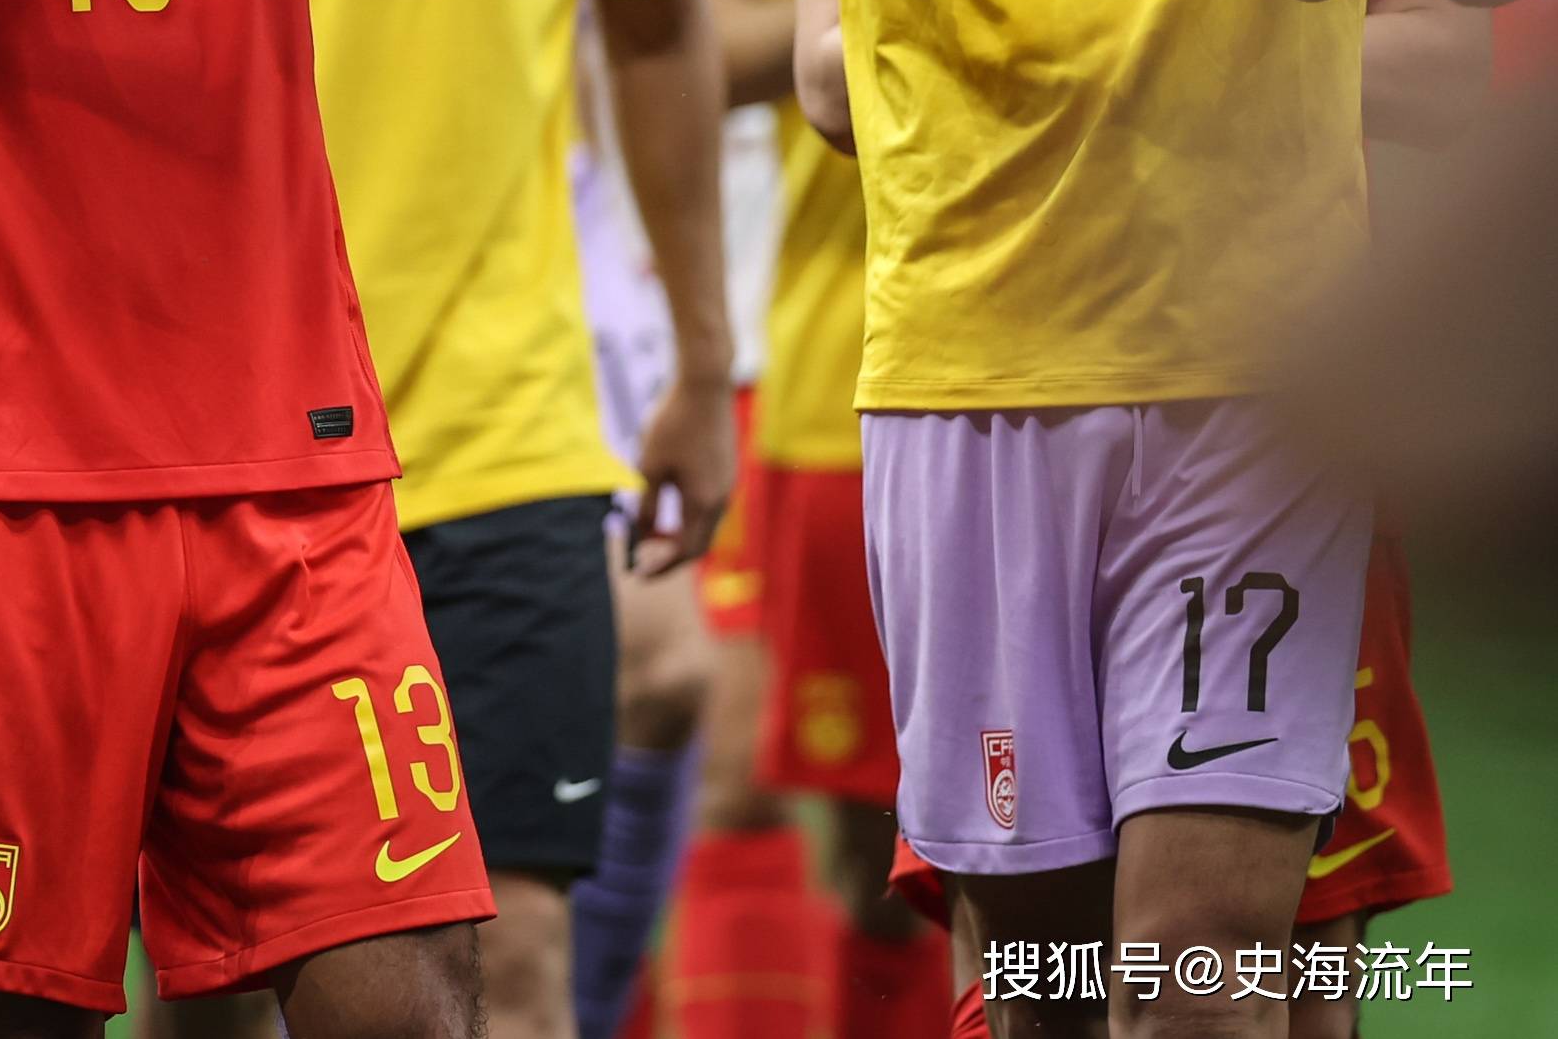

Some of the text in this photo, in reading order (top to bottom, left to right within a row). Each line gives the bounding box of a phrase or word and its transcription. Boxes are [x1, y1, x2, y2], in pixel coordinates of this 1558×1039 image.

[1180, 572, 1300, 713] 17
[331, 665, 461, 820] 13
[1346, 667, 1390, 811] 5
